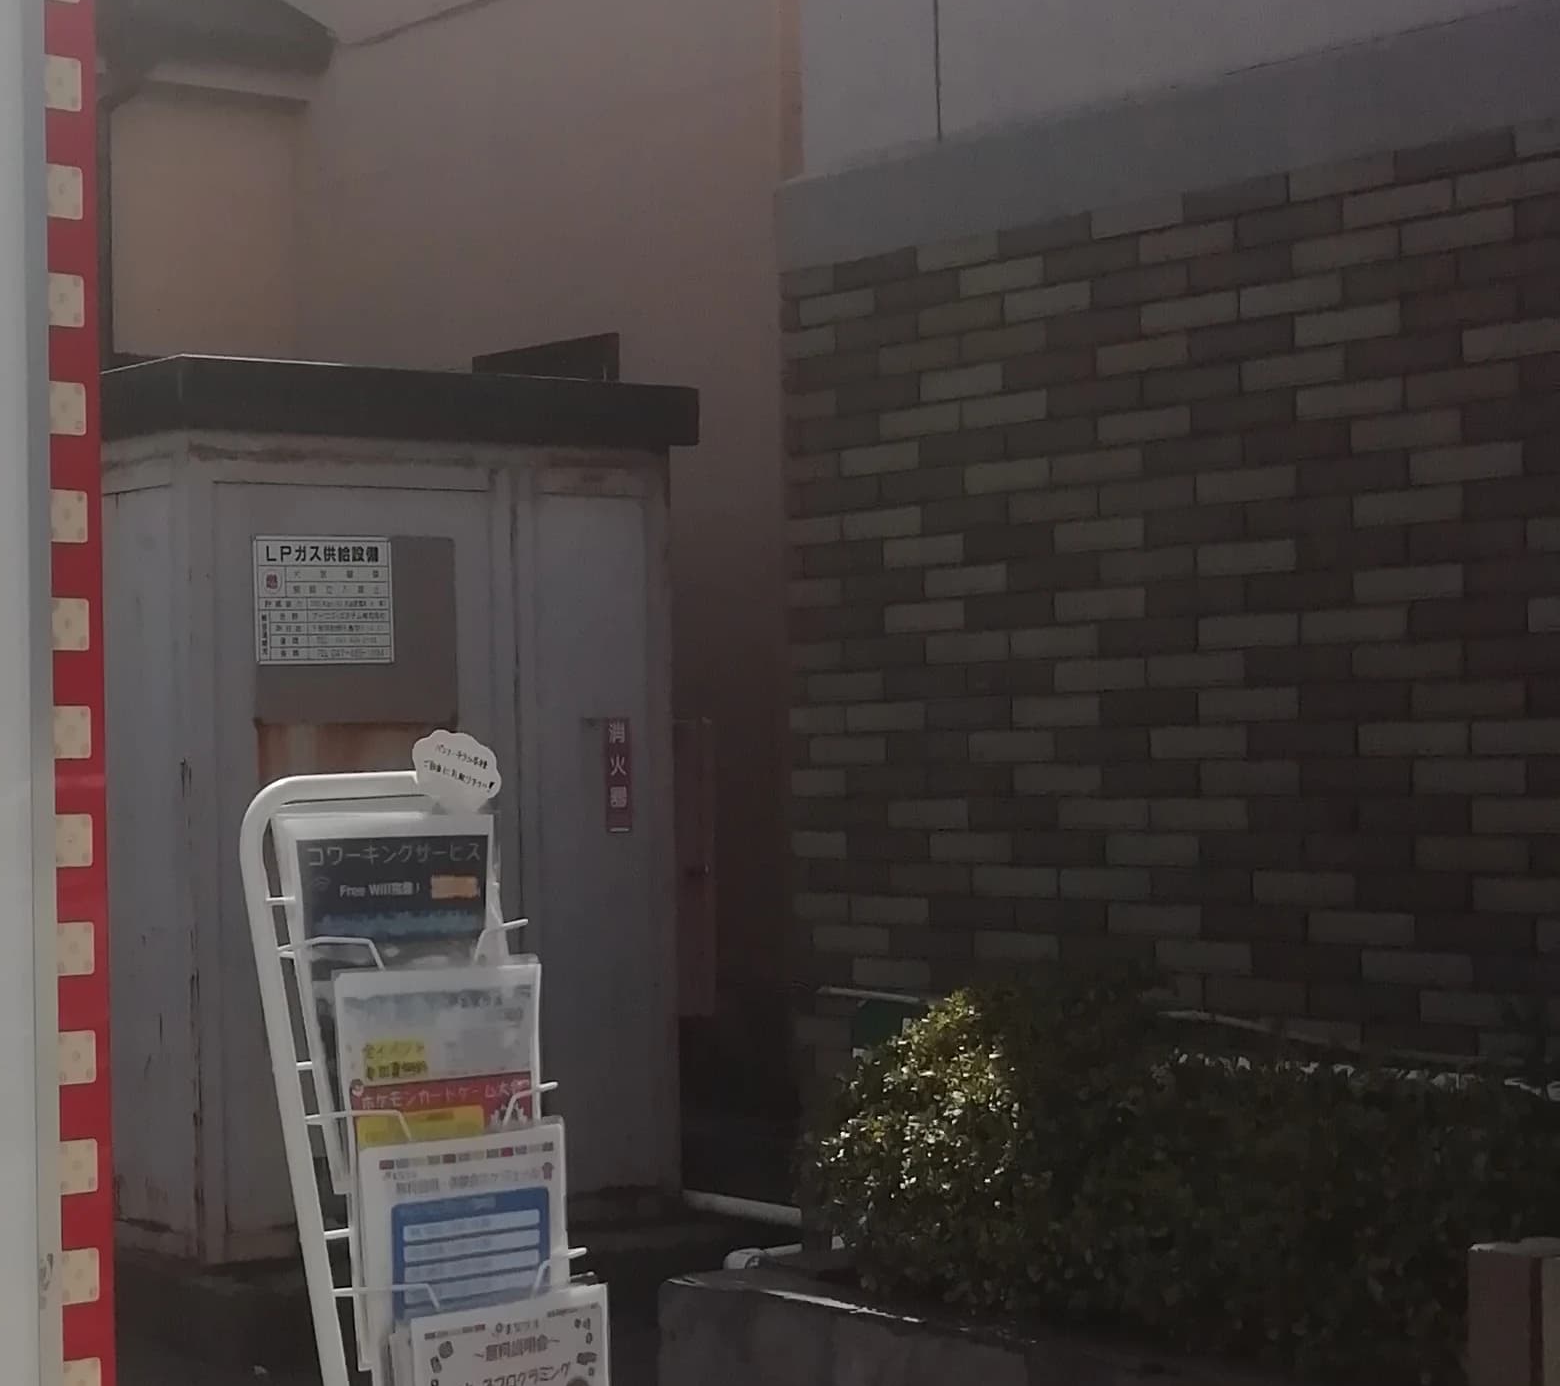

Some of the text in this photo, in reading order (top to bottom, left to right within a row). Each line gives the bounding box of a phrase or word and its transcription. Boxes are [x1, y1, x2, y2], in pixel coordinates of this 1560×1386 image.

[265, 544, 380, 563] LPガス供給設備
[608, 721, 628, 808] 消火器
[306, 842, 481, 867] コワーキングサービス
